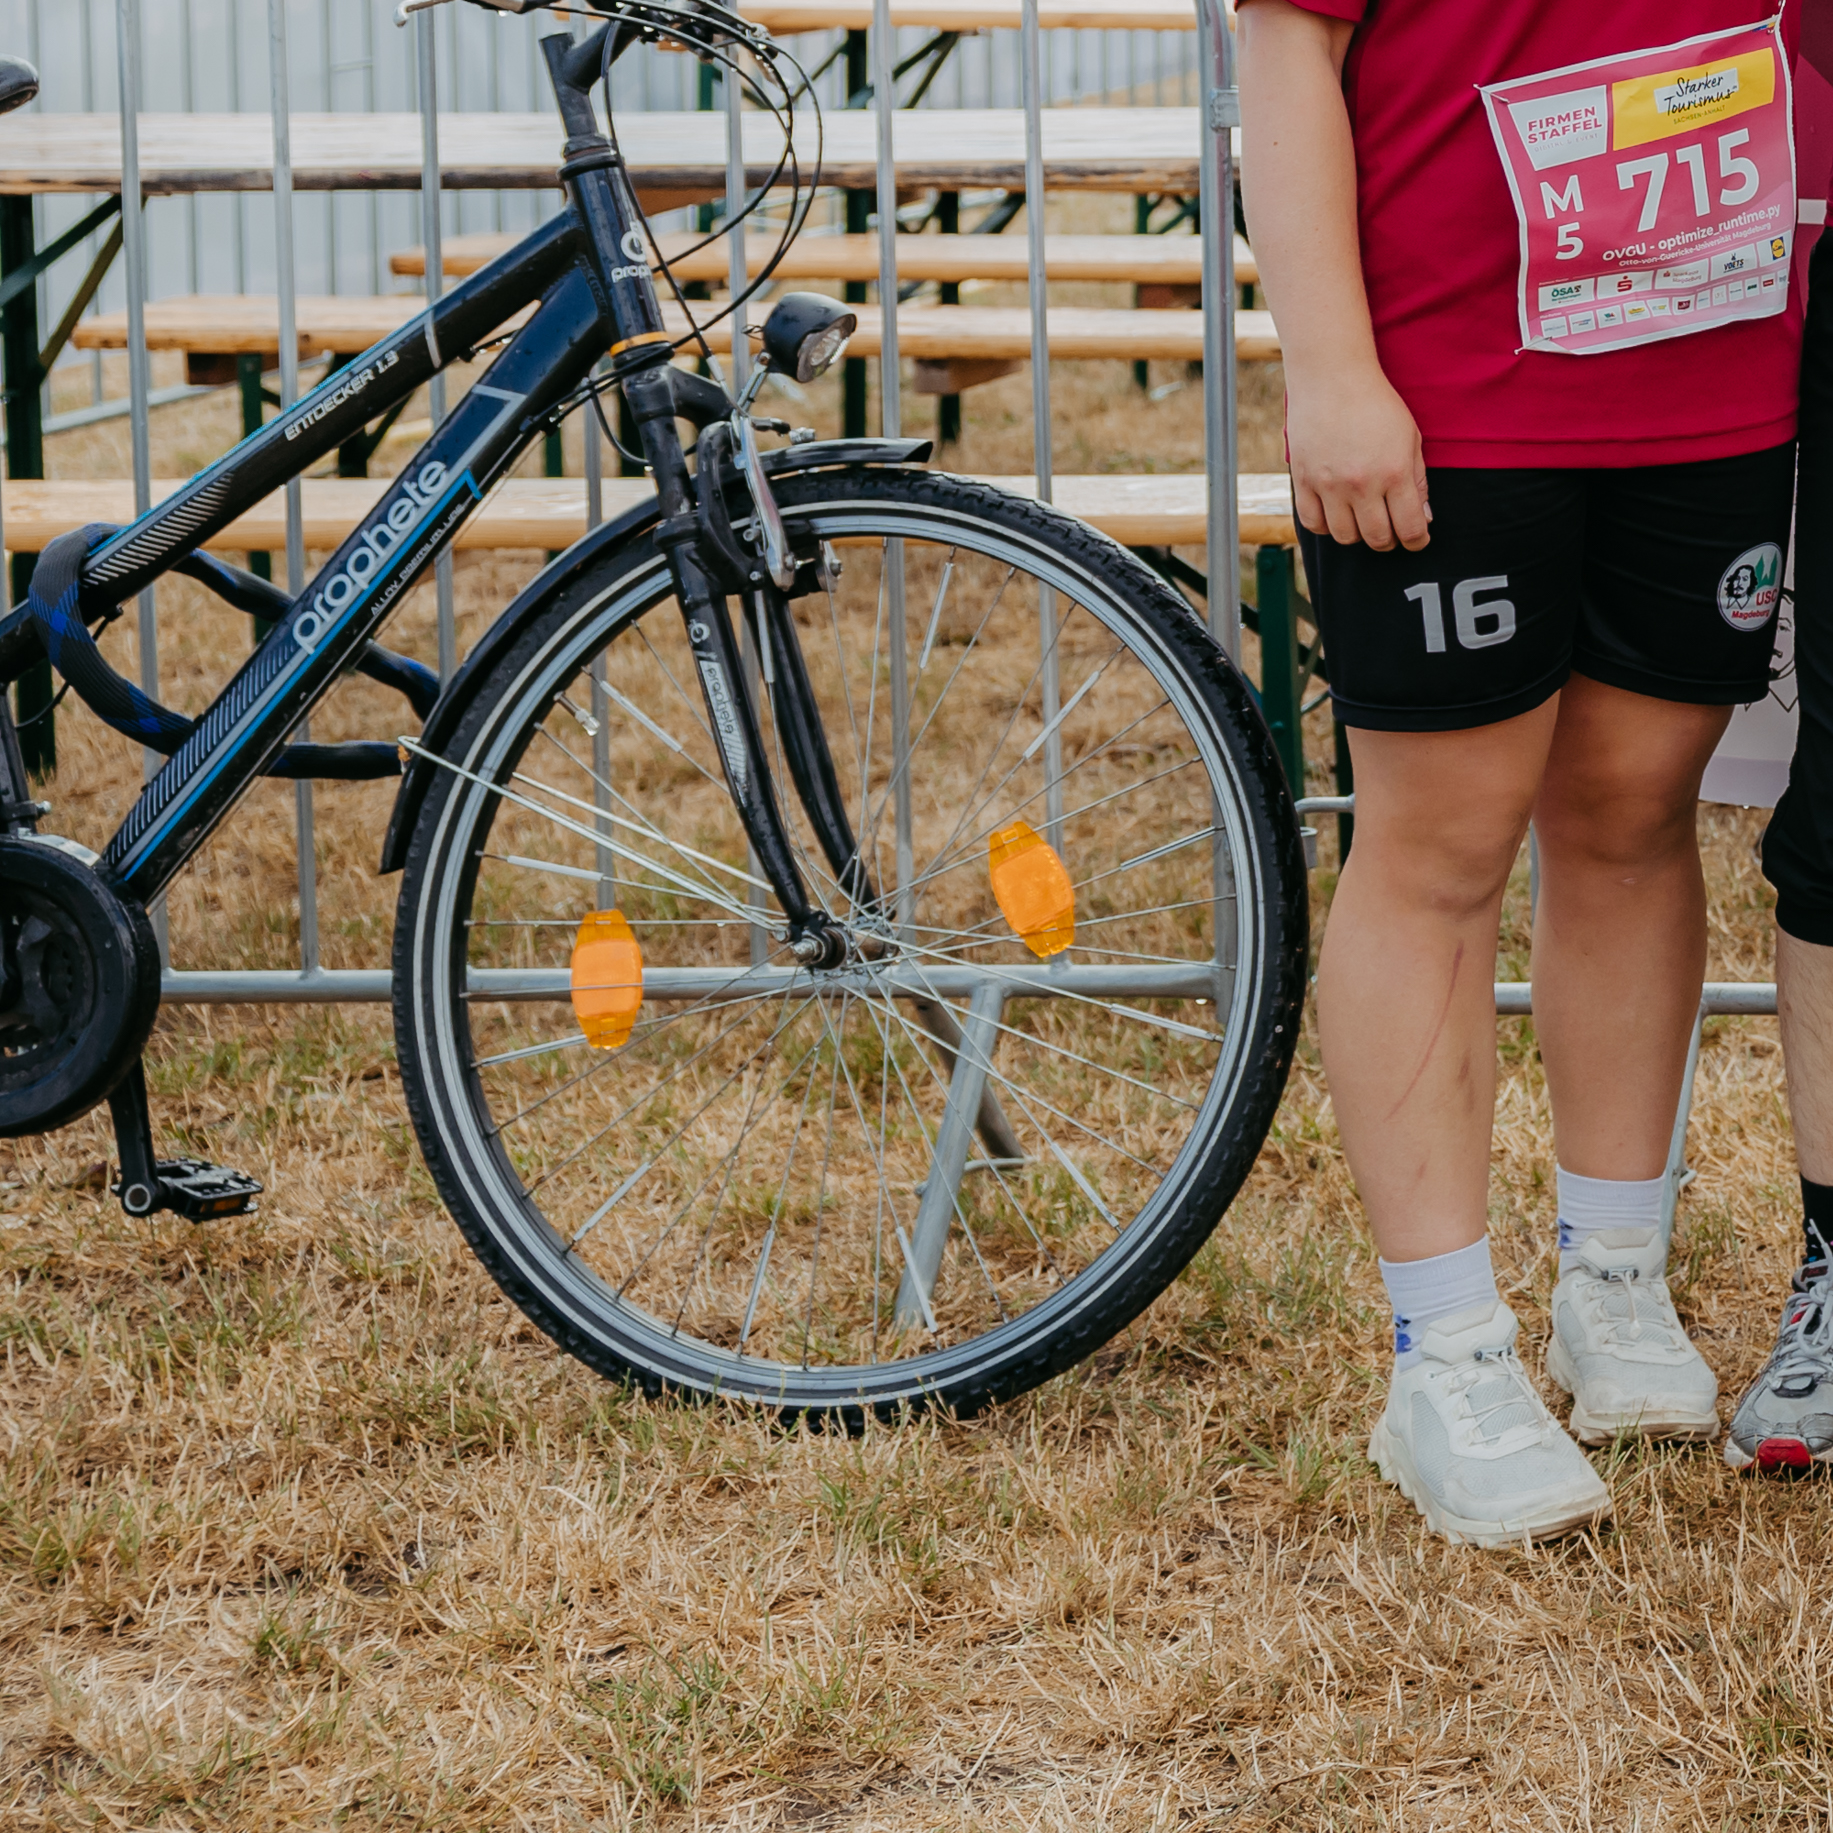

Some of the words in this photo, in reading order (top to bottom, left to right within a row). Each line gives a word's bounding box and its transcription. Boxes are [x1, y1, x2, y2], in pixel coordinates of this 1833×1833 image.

[1663, 88, 1735, 116] Tourismus
[1675, 71, 1724, 98] Starker
[1527, 106, 1596, 132] FIRMEN
[1527, 118, 1603, 144] STAFFEL
[1539, 174, 1585, 220] M
[1615, 127, 1760, 232] 715
[1555, 222, 1584, 261] 5
[1602, 241, 1647, 262] OVGU
[1657, 203, 1781, 252] optimize_runtime.py
[291, 460, 448, 656] prophete
[1403, 574, 1517, 653] 16
[1754, 588, 1779, 606] USC
